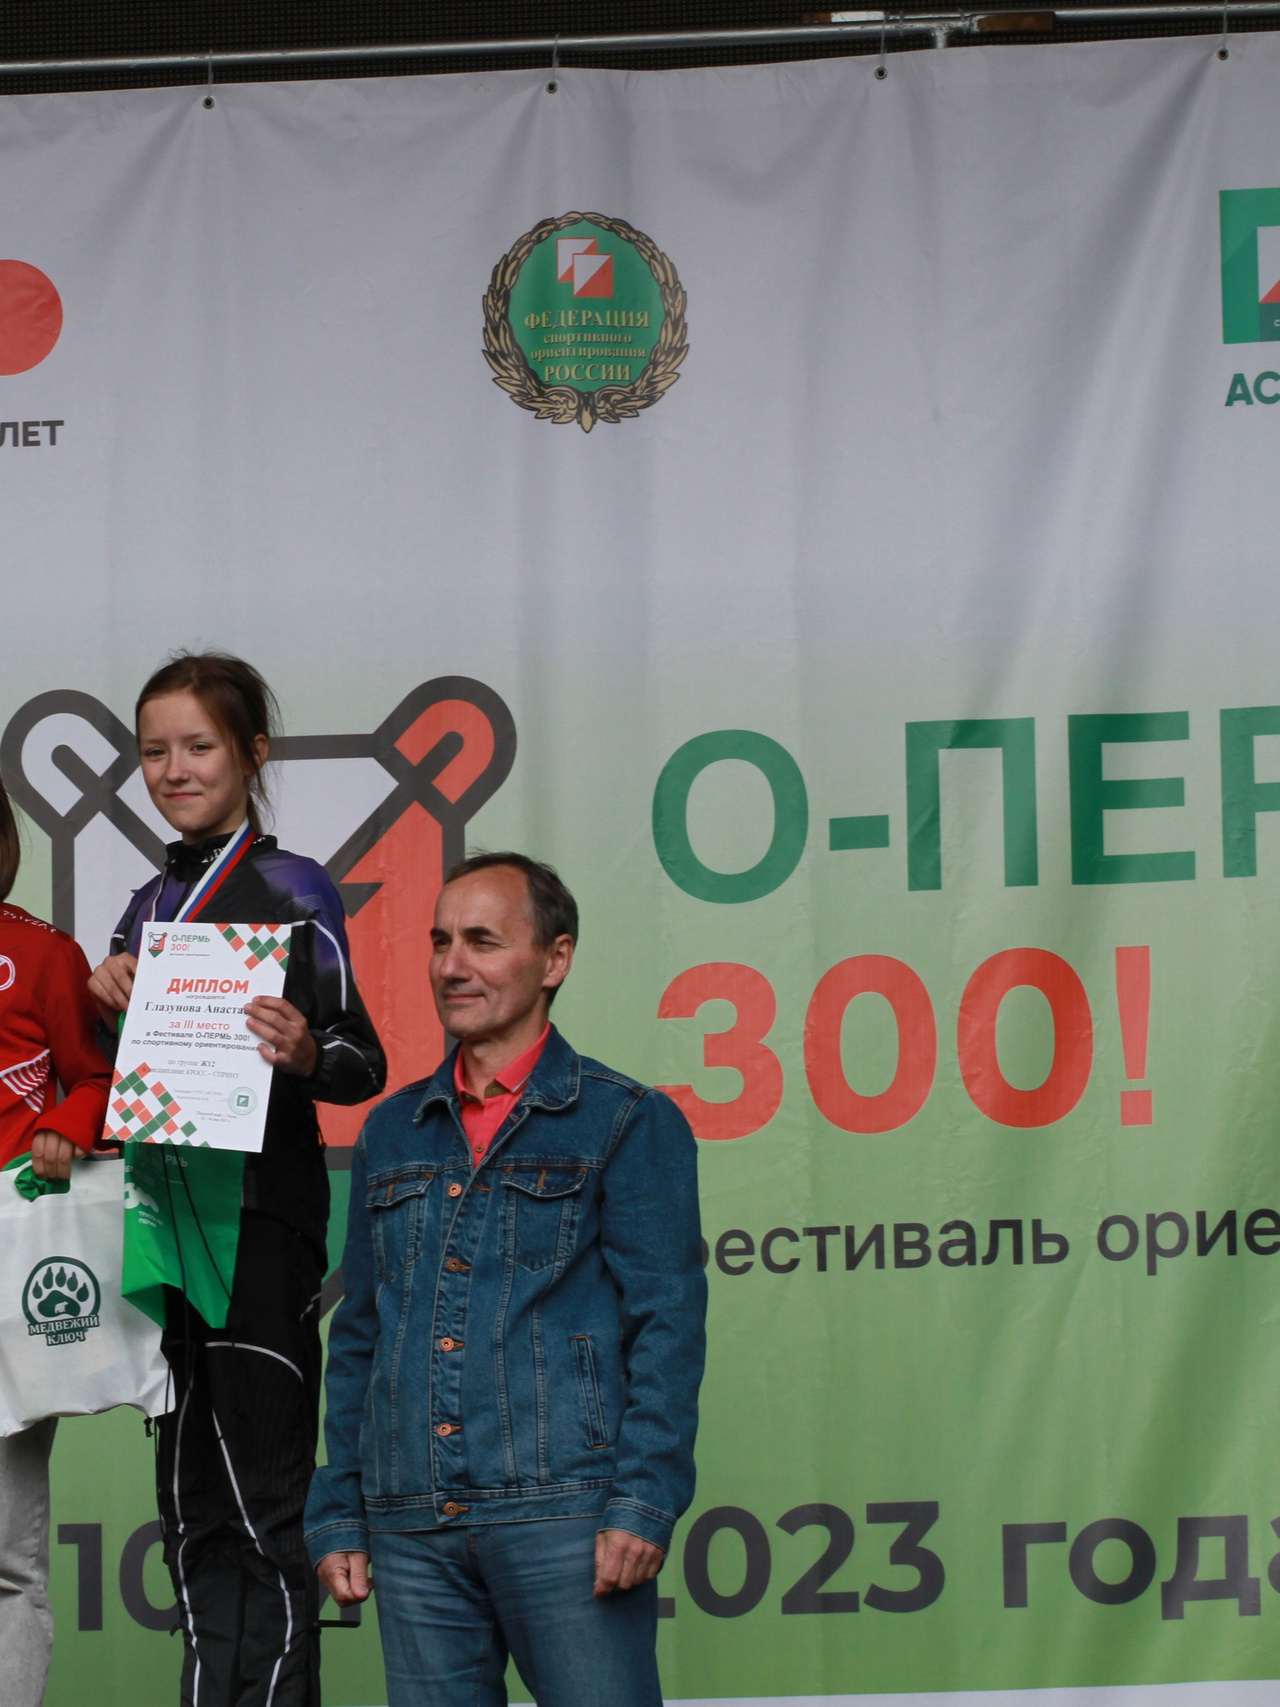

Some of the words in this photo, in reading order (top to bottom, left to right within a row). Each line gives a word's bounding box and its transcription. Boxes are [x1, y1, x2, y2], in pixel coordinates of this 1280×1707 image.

[524, 310, 650, 330] ФЕДЕРАЦИЯ
[543, 331, 632, 346] спортивного
[530, 346, 646, 362] ориентирования
[544, 363, 632, 382] РОССИИ
[171, 934, 210, 943] О-ПЕРМЬ
[166, 978, 250, 995] ДИПЛОМ
[144, 1001, 201, 1014] Глазунова
[168, 1021, 180, 1029] за
[183, 1020, 194, 1029] III
[196, 1022, 230, 1030] место
[152, 1030, 193, 1039] Фестивале
[195, 1031, 232, 1040] О-ПЕРМЬ
[653, 945, 1153, 1141] 300!
[142, 1039, 192, 1048] спортивному
[700, 1217, 1070, 1277] естиваль
[29, 1314, 99, 1335] МЕДВЕЖИЙ
[47, 1331, 85, 1346] КЛЮЧ
[658, 1500, 946, 1619] 023
[1001, 1513, 1280, 1621] год
